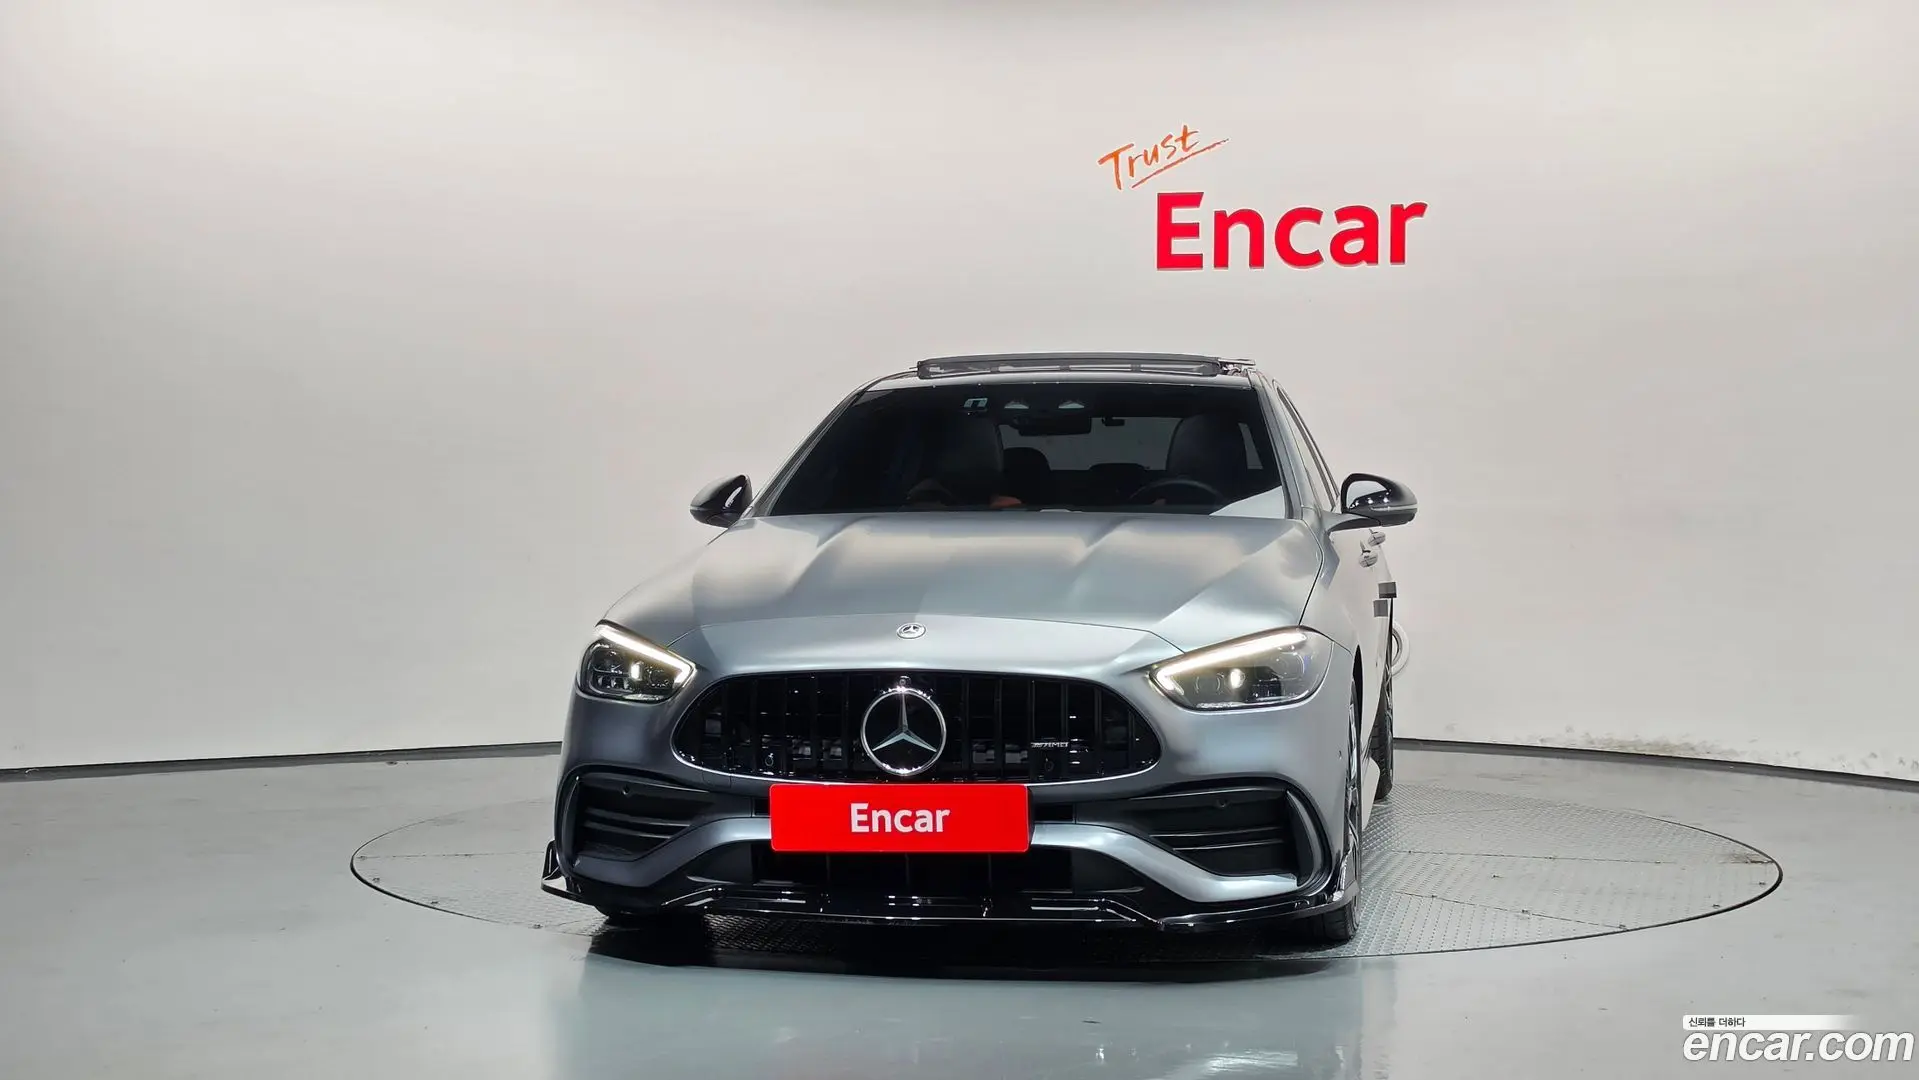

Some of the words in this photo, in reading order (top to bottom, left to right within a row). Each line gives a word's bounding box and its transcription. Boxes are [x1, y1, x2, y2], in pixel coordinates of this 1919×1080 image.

[1098, 125, 1200, 190] Trust
[1156, 191, 1428, 271] Encar
[850, 802, 951, 833] Encar
